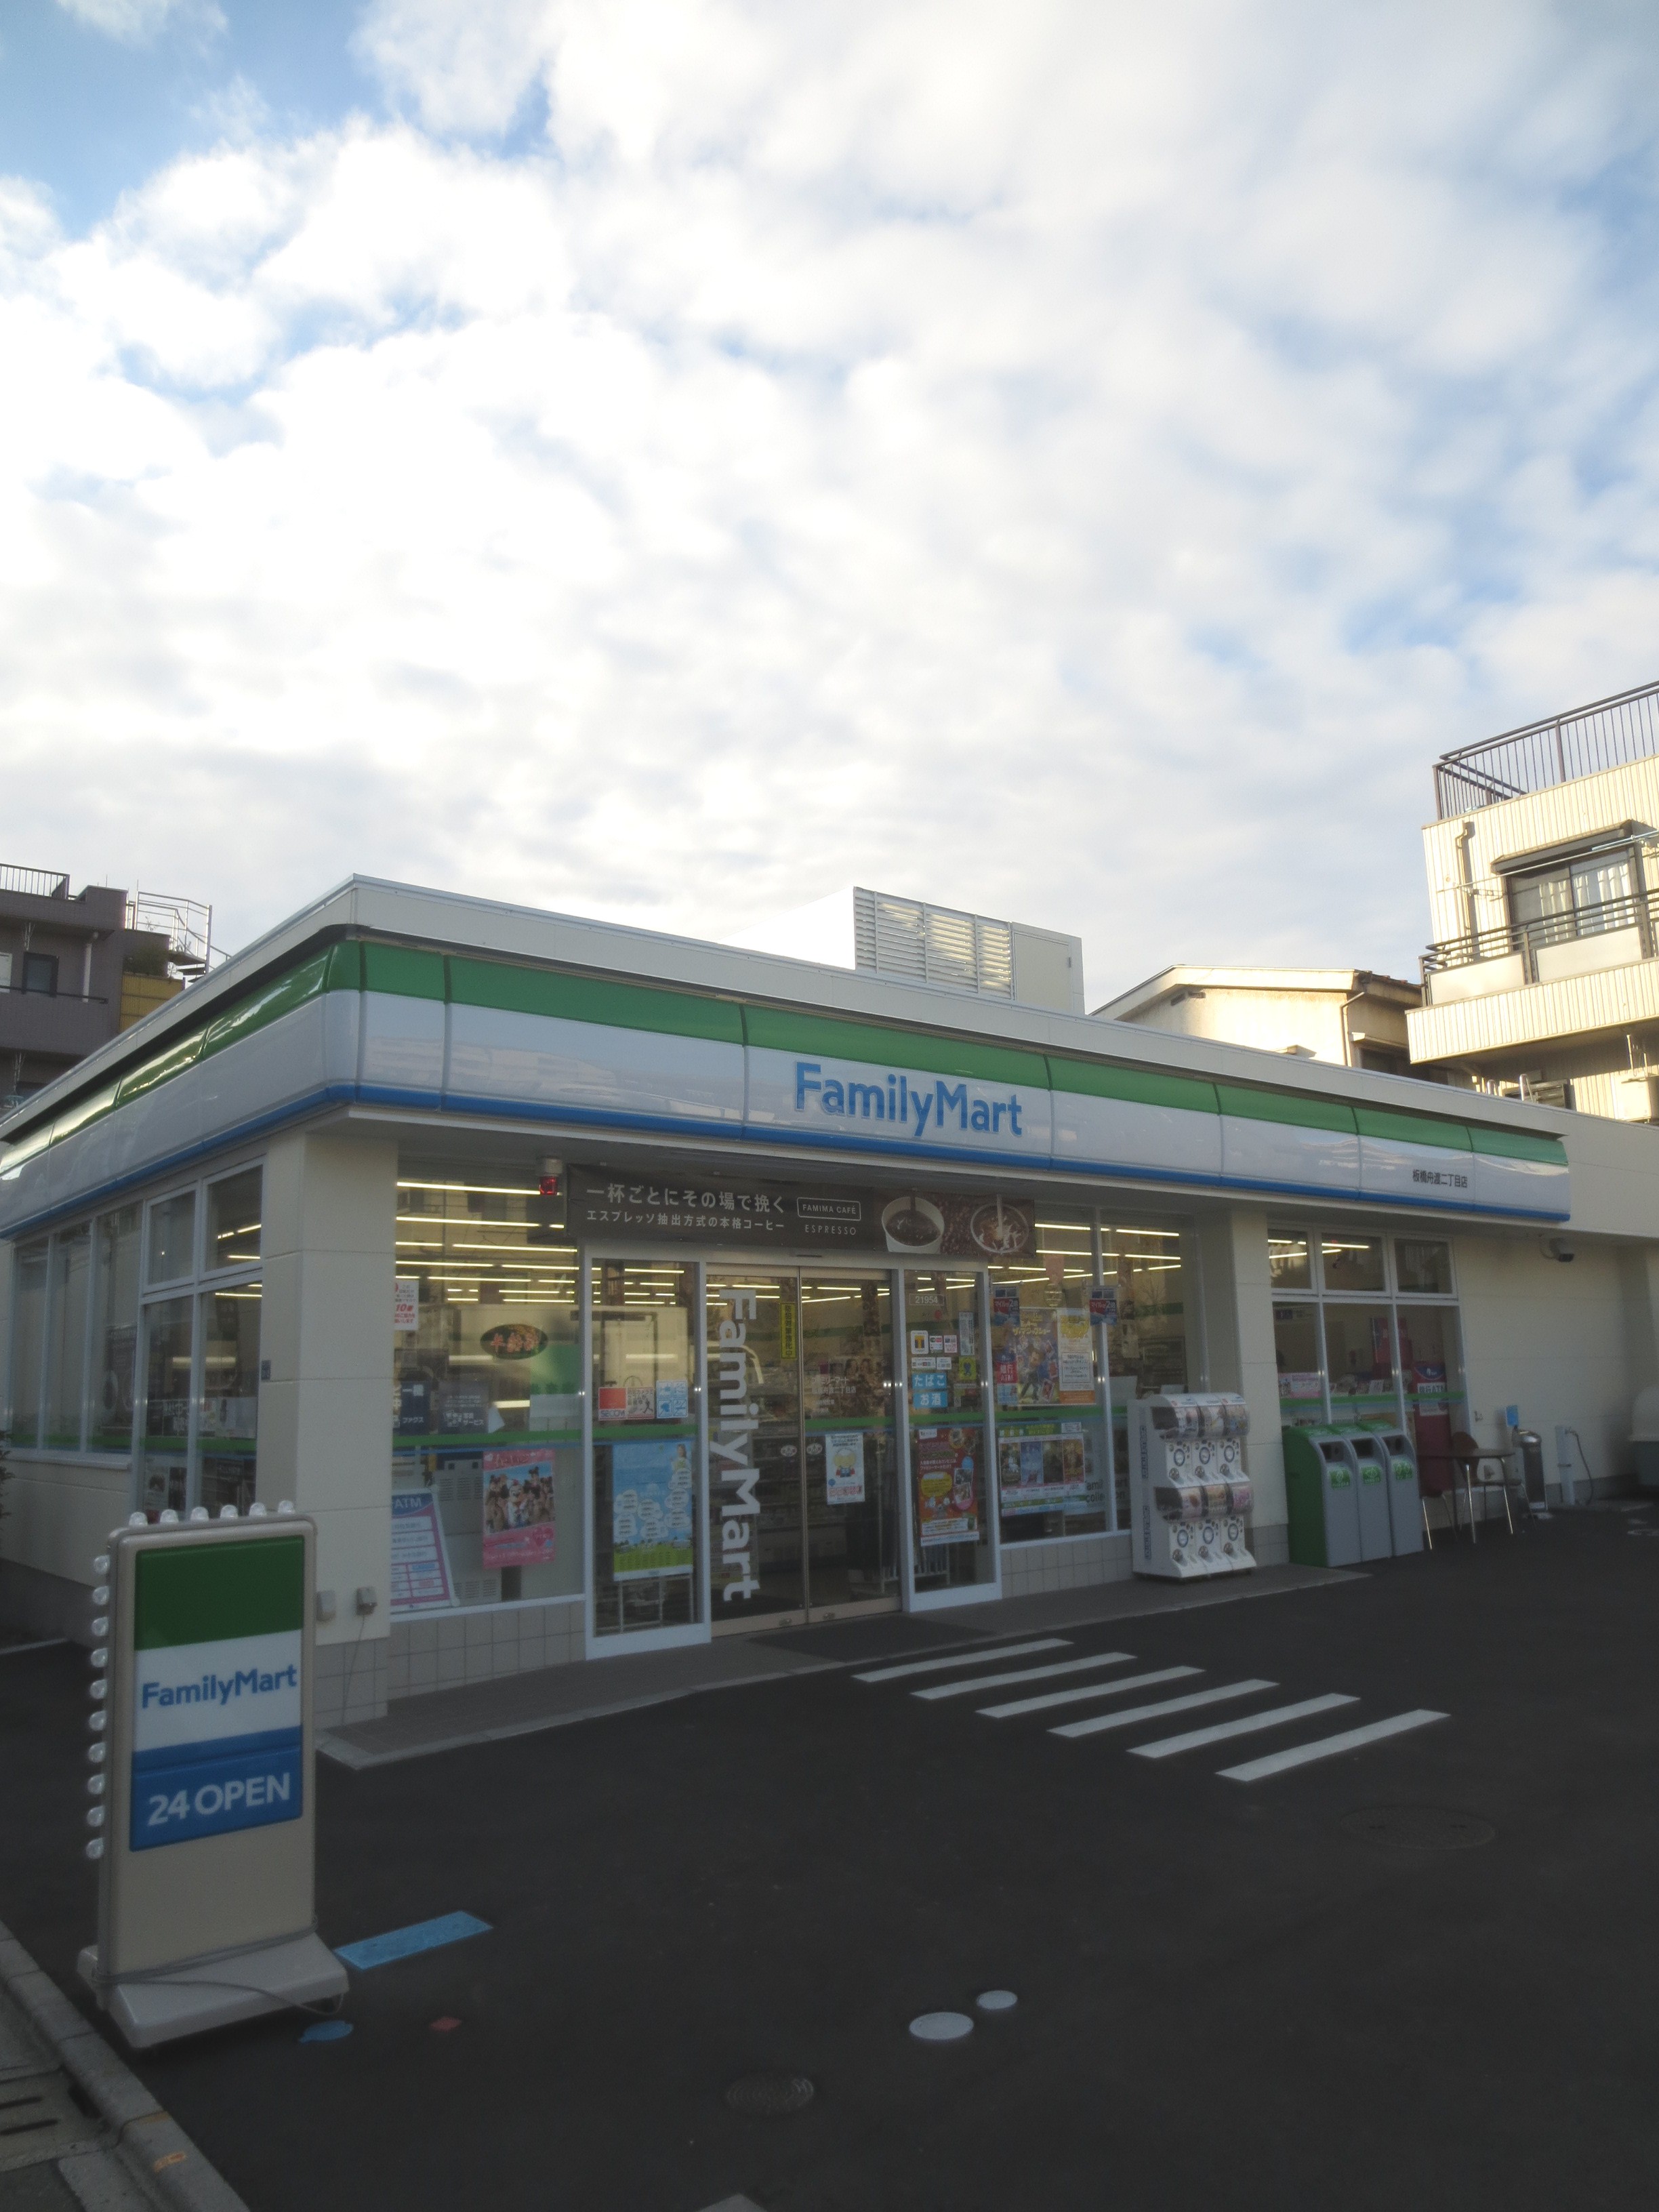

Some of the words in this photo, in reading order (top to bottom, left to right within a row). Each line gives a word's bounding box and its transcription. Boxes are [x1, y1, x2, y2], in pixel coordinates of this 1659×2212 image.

[796, 1062, 1022, 1136] FamilyMart
[1412, 1168, 1468, 1188] 板橋舟渡二丁目店
[587, 1183, 784, 1213] 一杯ごとにその場で挽く
[802, 1204, 834, 1213] FAMIMA
[836, 1206, 857, 1214] CAFÉ
[587, 1210, 784, 1231] エスプレッソ抽出方式の本格コーヒー
[805, 1225, 857, 1235] ESPRESSO
[914, 1375, 945, 1386] たばこ
[920, 1393, 941, 1406] お酒
[710, 1289, 760, 1602] FamilyMart
[394, 1498, 422, 1509] ATM
[142, 1664, 297, 1709] FamilyMart
[147, 1789, 190, 1826] 24
[194, 1772, 291, 1816] OPEN
